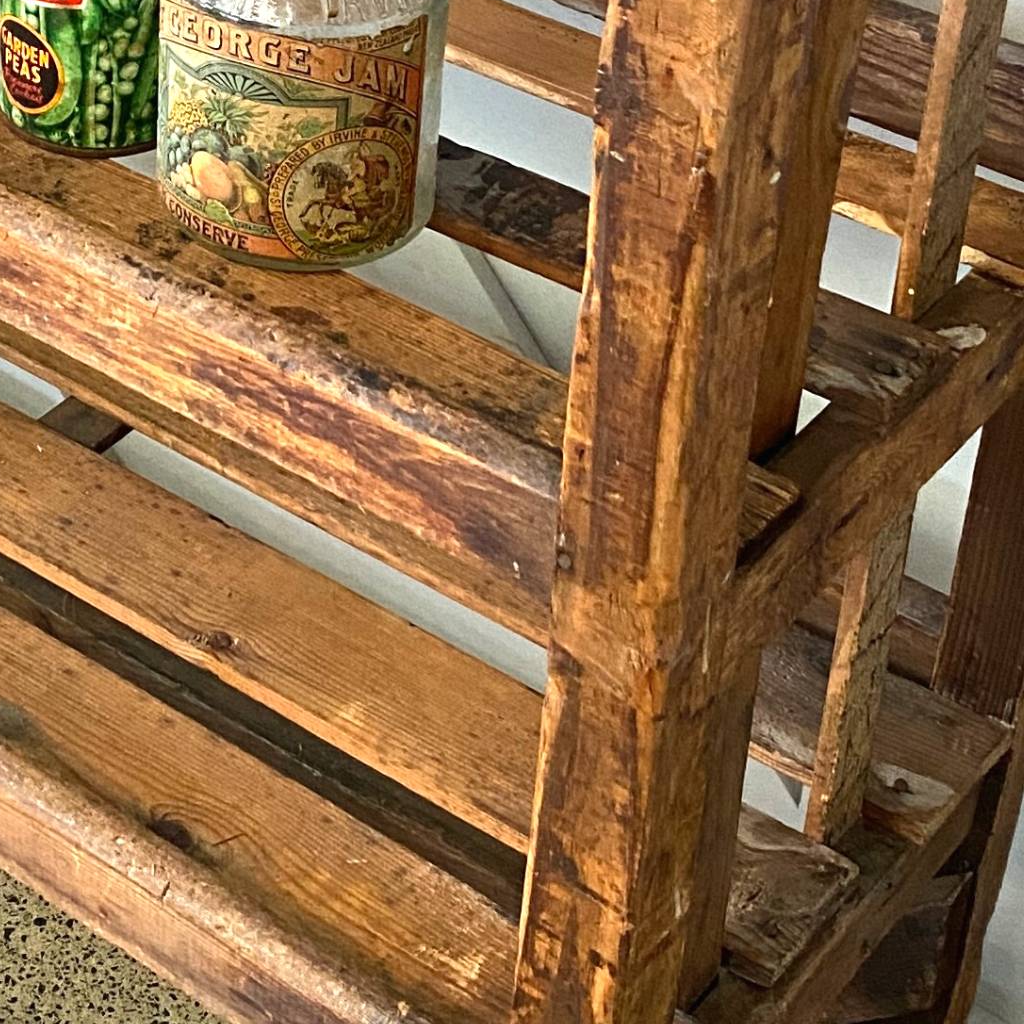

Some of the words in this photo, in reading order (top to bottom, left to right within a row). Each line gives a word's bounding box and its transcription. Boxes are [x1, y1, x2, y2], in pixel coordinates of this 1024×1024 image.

[1, 26, 50, 69] GARDEN
[4, 46, 42, 84] PEAS
[169, 7, 311, 76] GEORGE
[333, 53, 410, 105] JAM
[271, 147, 310, 190] PREPARED
[311, 137, 326, 151] BY
[166, 196, 249, 251] CONSERVE
